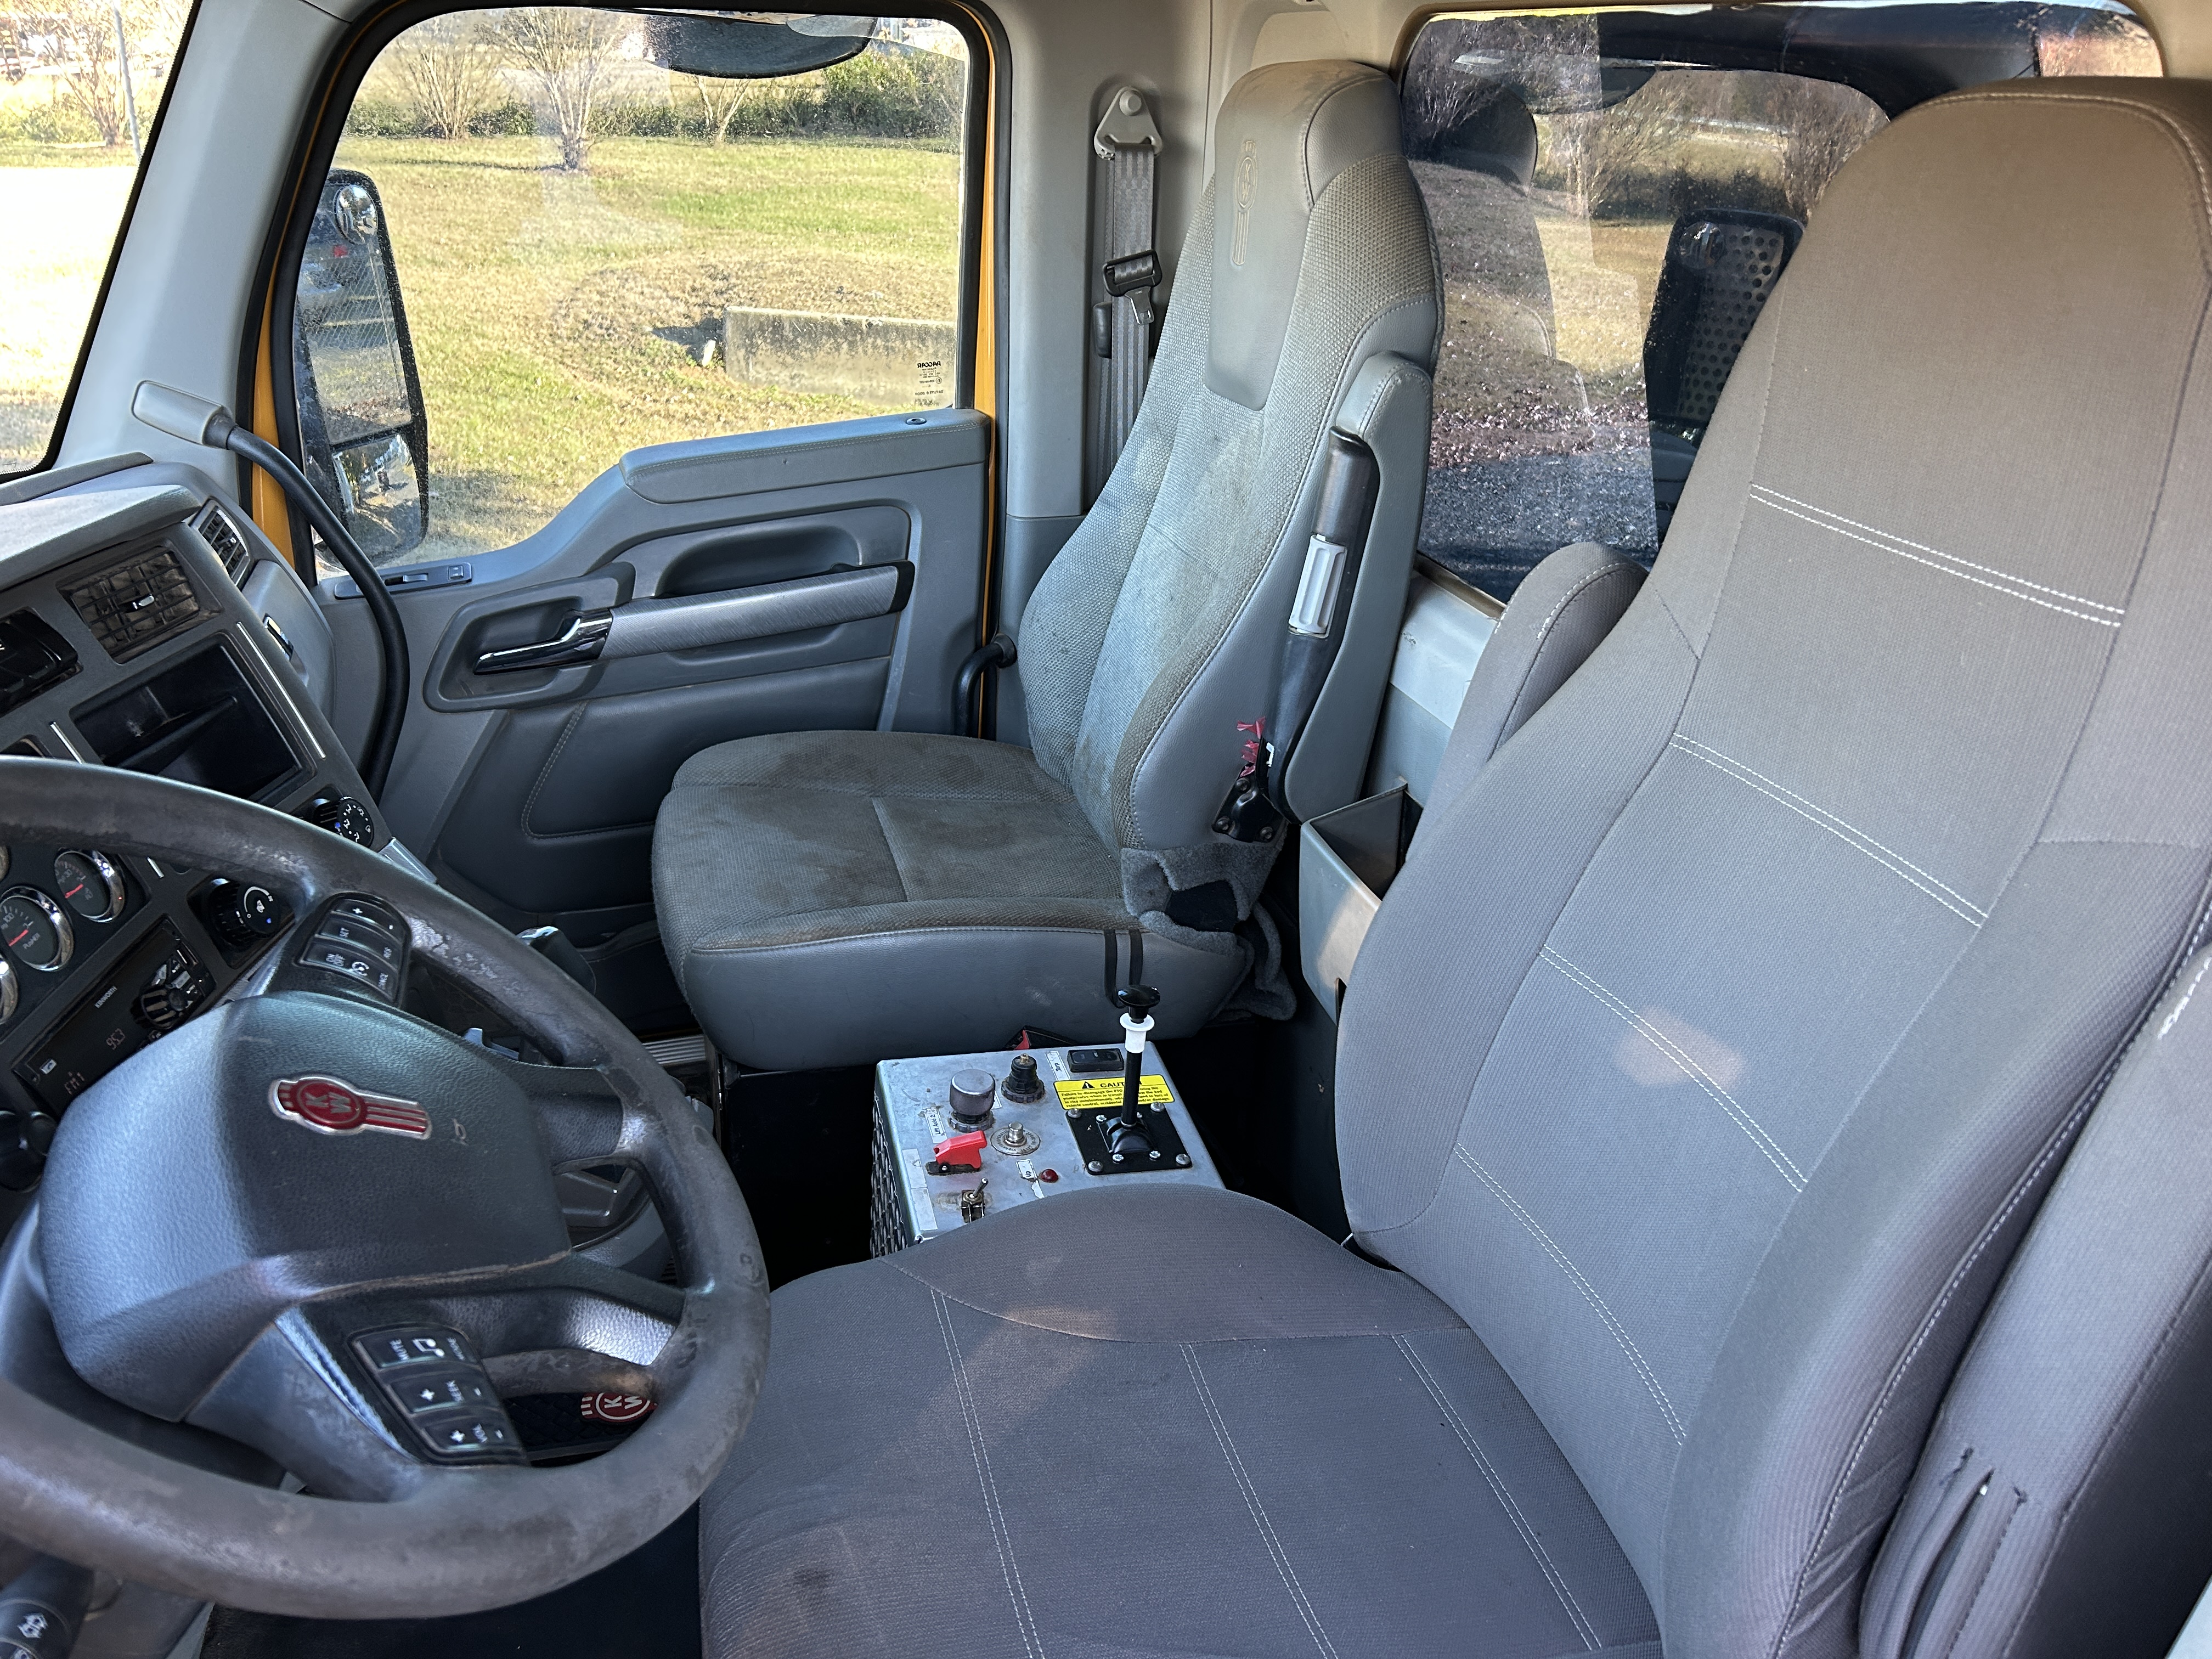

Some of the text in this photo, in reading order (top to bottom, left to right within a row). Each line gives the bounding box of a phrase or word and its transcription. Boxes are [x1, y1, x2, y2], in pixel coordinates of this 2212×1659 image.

[339, 927, 350, 938] SET
[94, 986, 117, 1008] KENWORTH
[304, 1091, 352, 1114] KW
[390, 1338, 410, 1361] MUTE
[446, 1337, 465, 1361] MODE
[446, 1380, 465, 1401] SEEK
[472, 1424, 488, 1443] VOL
